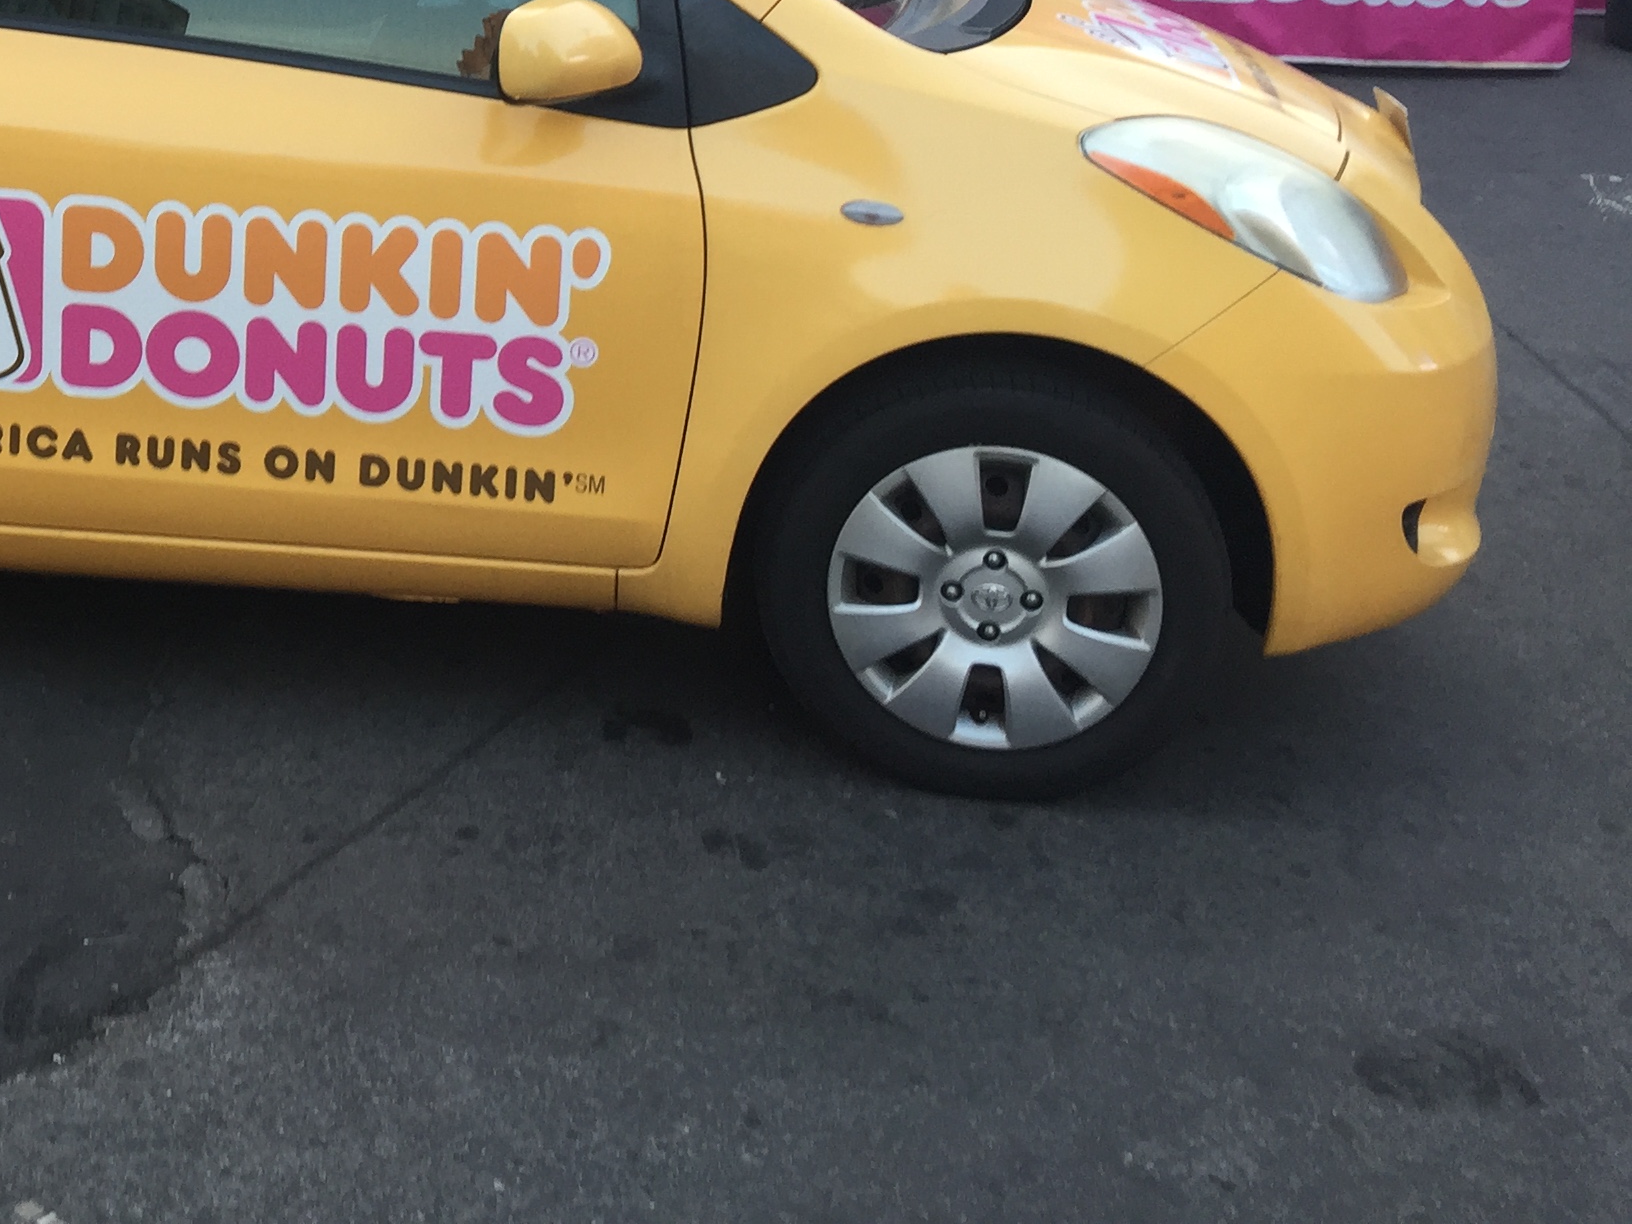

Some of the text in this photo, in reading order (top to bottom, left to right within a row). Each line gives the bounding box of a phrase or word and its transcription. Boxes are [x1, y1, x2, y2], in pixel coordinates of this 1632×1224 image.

[61, 205, 602, 327] DUNKIN'
[60, 302, 565, 427] DONUTS
[114, 432, 242, 477] RUNS
[263, 445, 338, 484] ON
